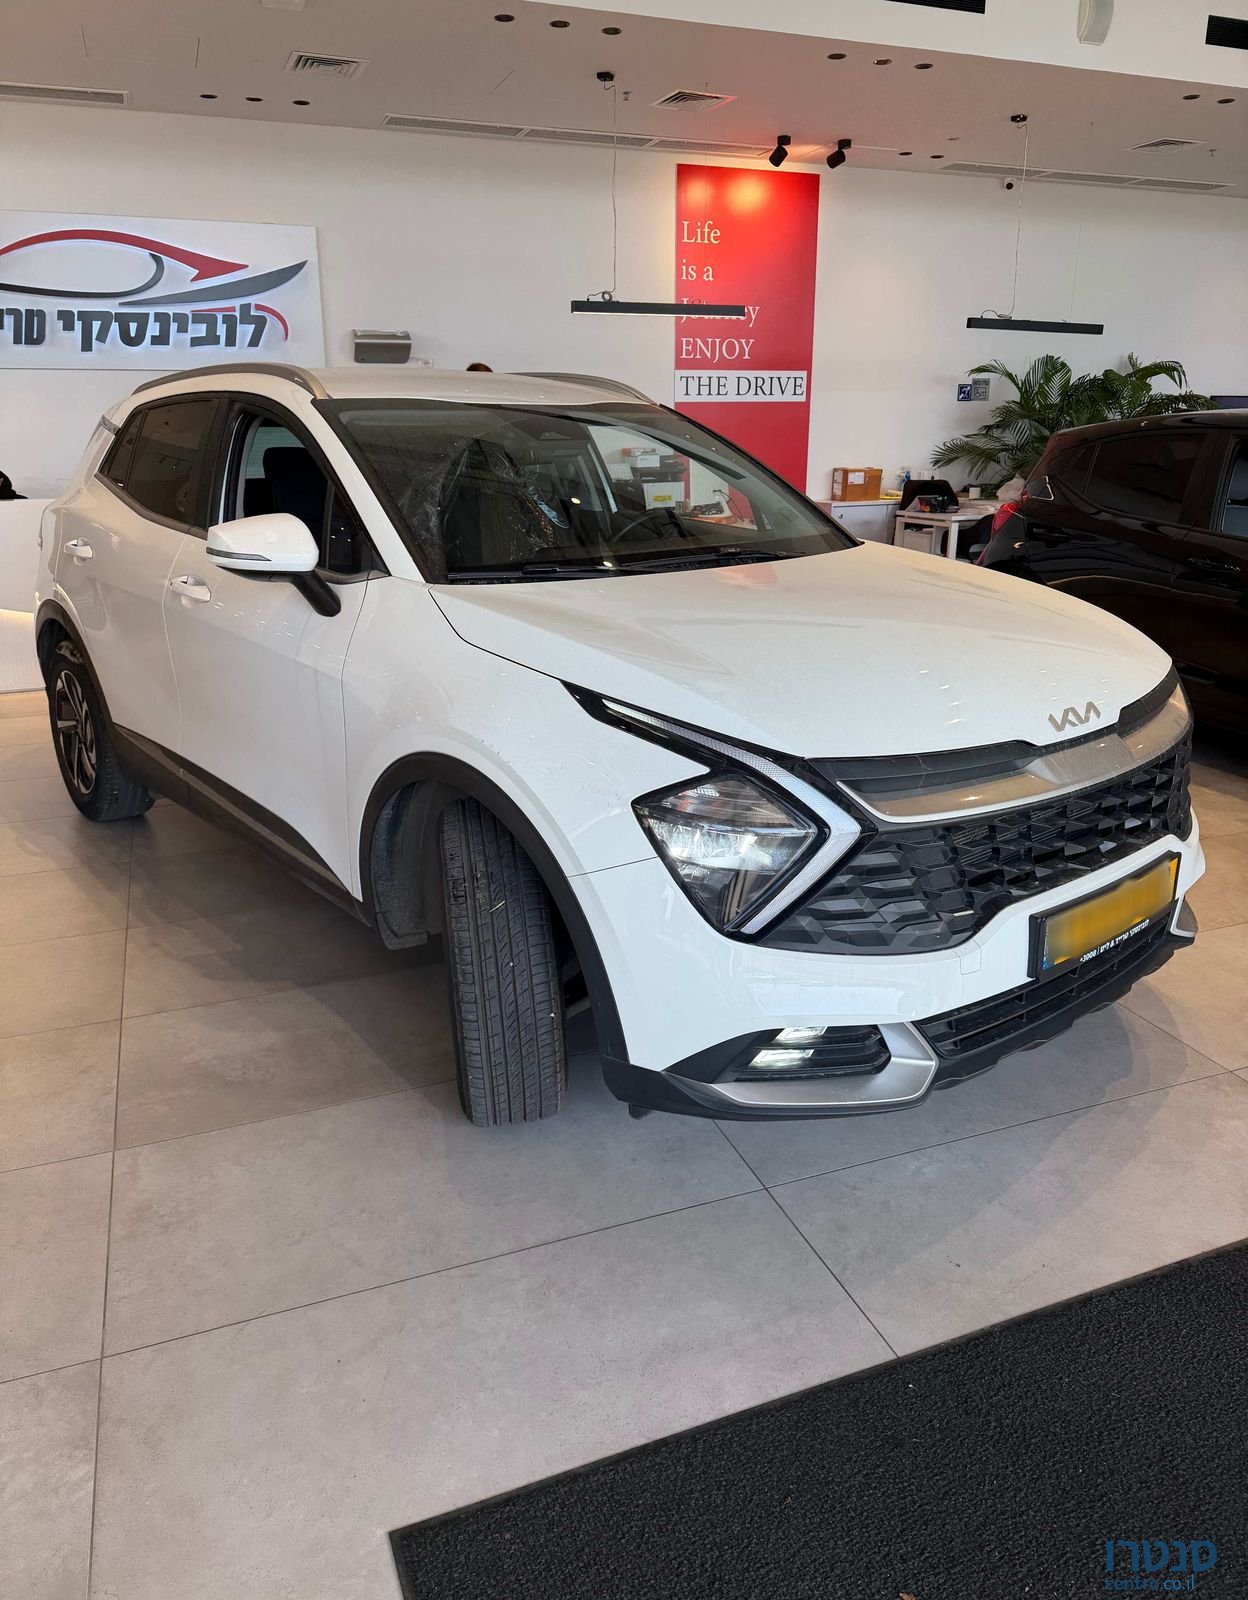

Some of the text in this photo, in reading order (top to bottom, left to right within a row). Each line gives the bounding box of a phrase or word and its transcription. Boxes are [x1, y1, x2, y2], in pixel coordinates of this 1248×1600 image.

[681, 220, 721, 244] Life
[680, 258, 715, 282] is a
[0, 302, 268, 352] לובינסקי טר
[680, 337, 756, 363] ENJOY
[679, 375, 805, 397] THE DRIVE
